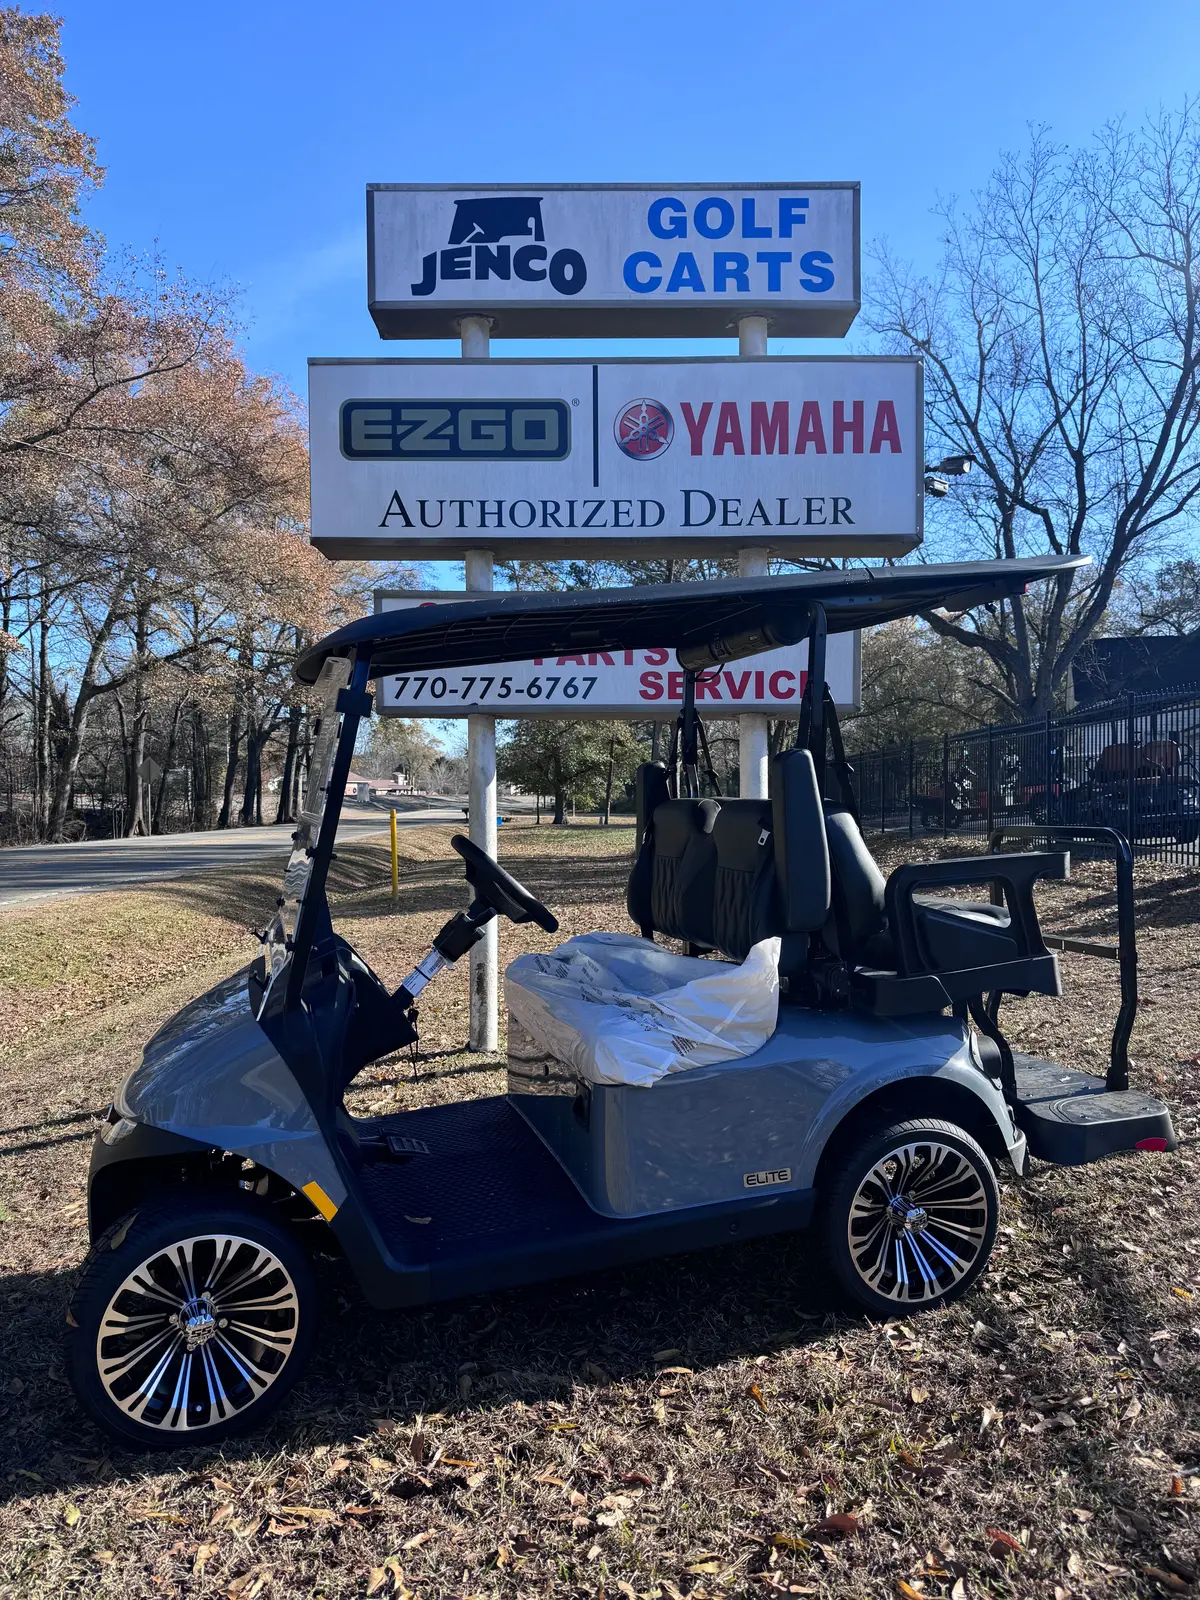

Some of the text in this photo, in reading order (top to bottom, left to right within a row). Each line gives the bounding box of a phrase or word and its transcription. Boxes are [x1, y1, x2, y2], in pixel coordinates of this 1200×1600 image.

[647, 197, 810, 239] GOLF
[411, 244, 587, 296] JENCO
[623, 251, 835, 294] CARTS
[680, 400, 902, 456] YAMAHA
[394, 676, 598, 700] 770-775-6767
